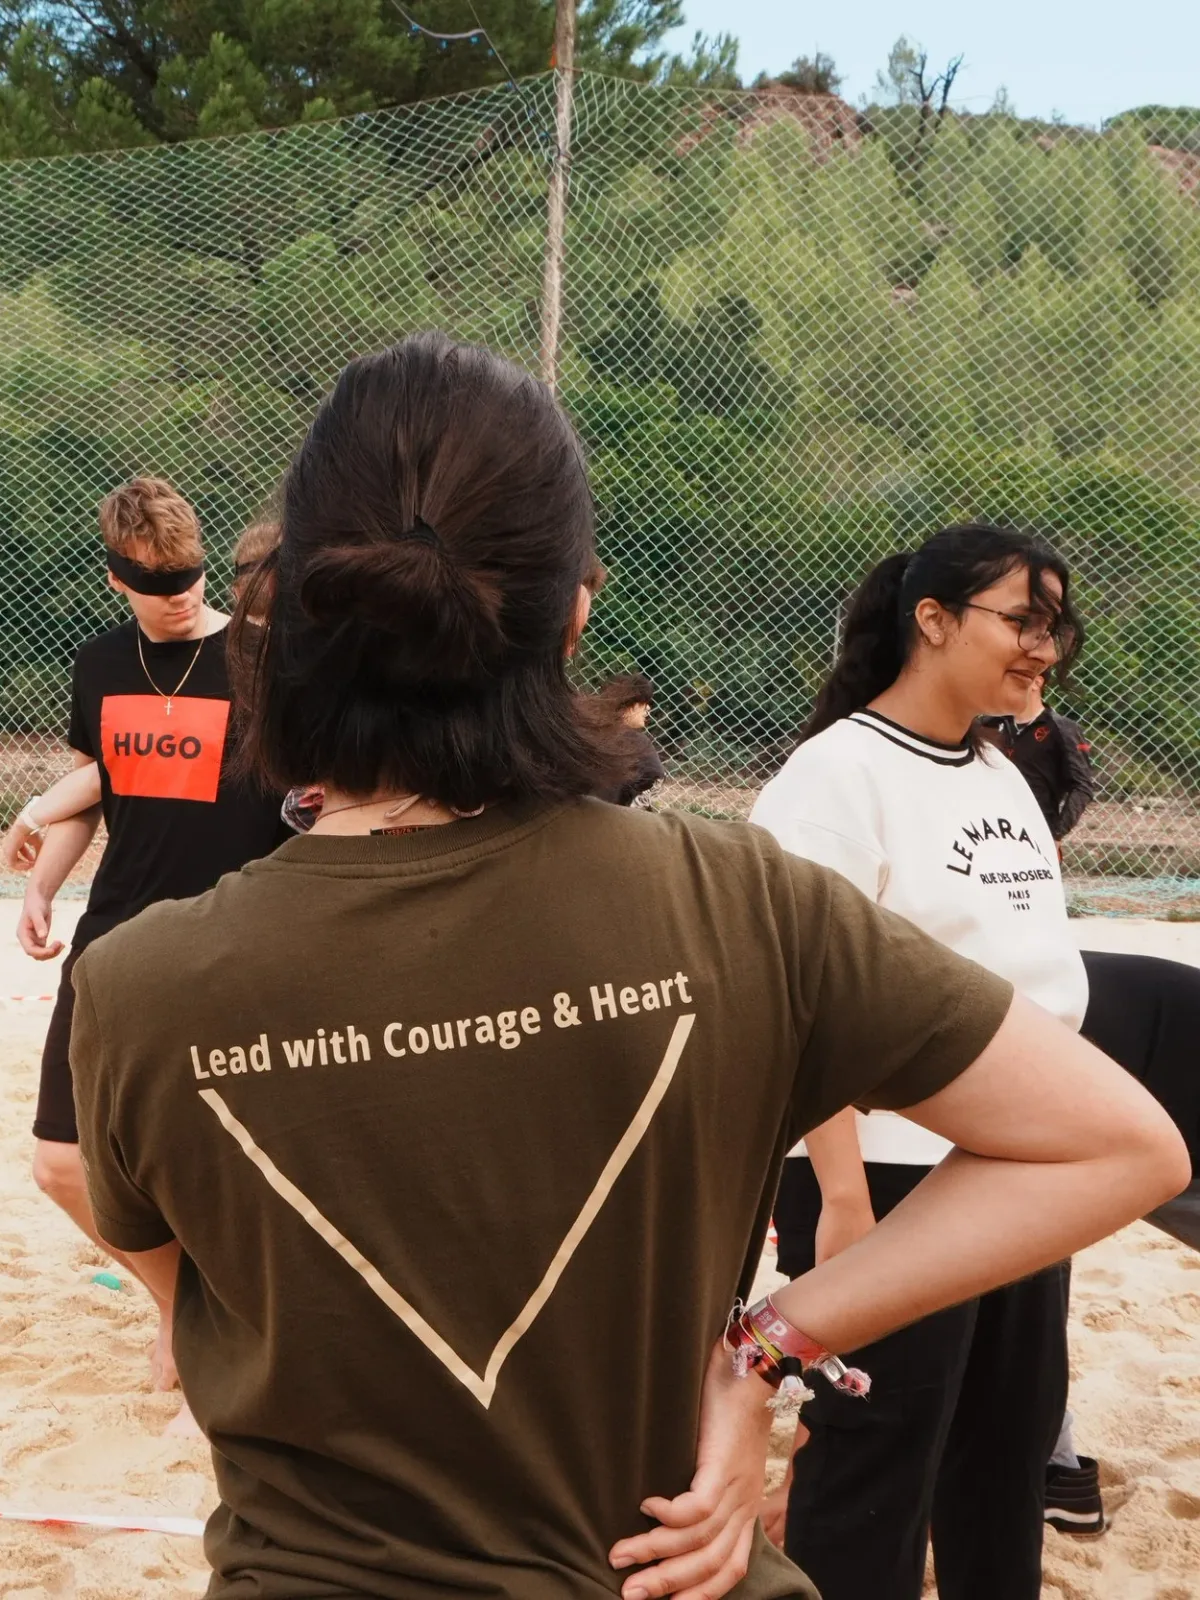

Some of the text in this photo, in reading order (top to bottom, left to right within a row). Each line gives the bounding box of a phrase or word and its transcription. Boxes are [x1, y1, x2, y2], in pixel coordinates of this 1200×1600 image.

[114, 733, 201, 759] HUGO
[946, 840, 974, 876] LE
[980, 869, 1053, 884] RUE DES ROSIERS
[1008, 889, 1030, 900] PARIS
[190, 971, 693, 1079] Lead with Courage & Heart
